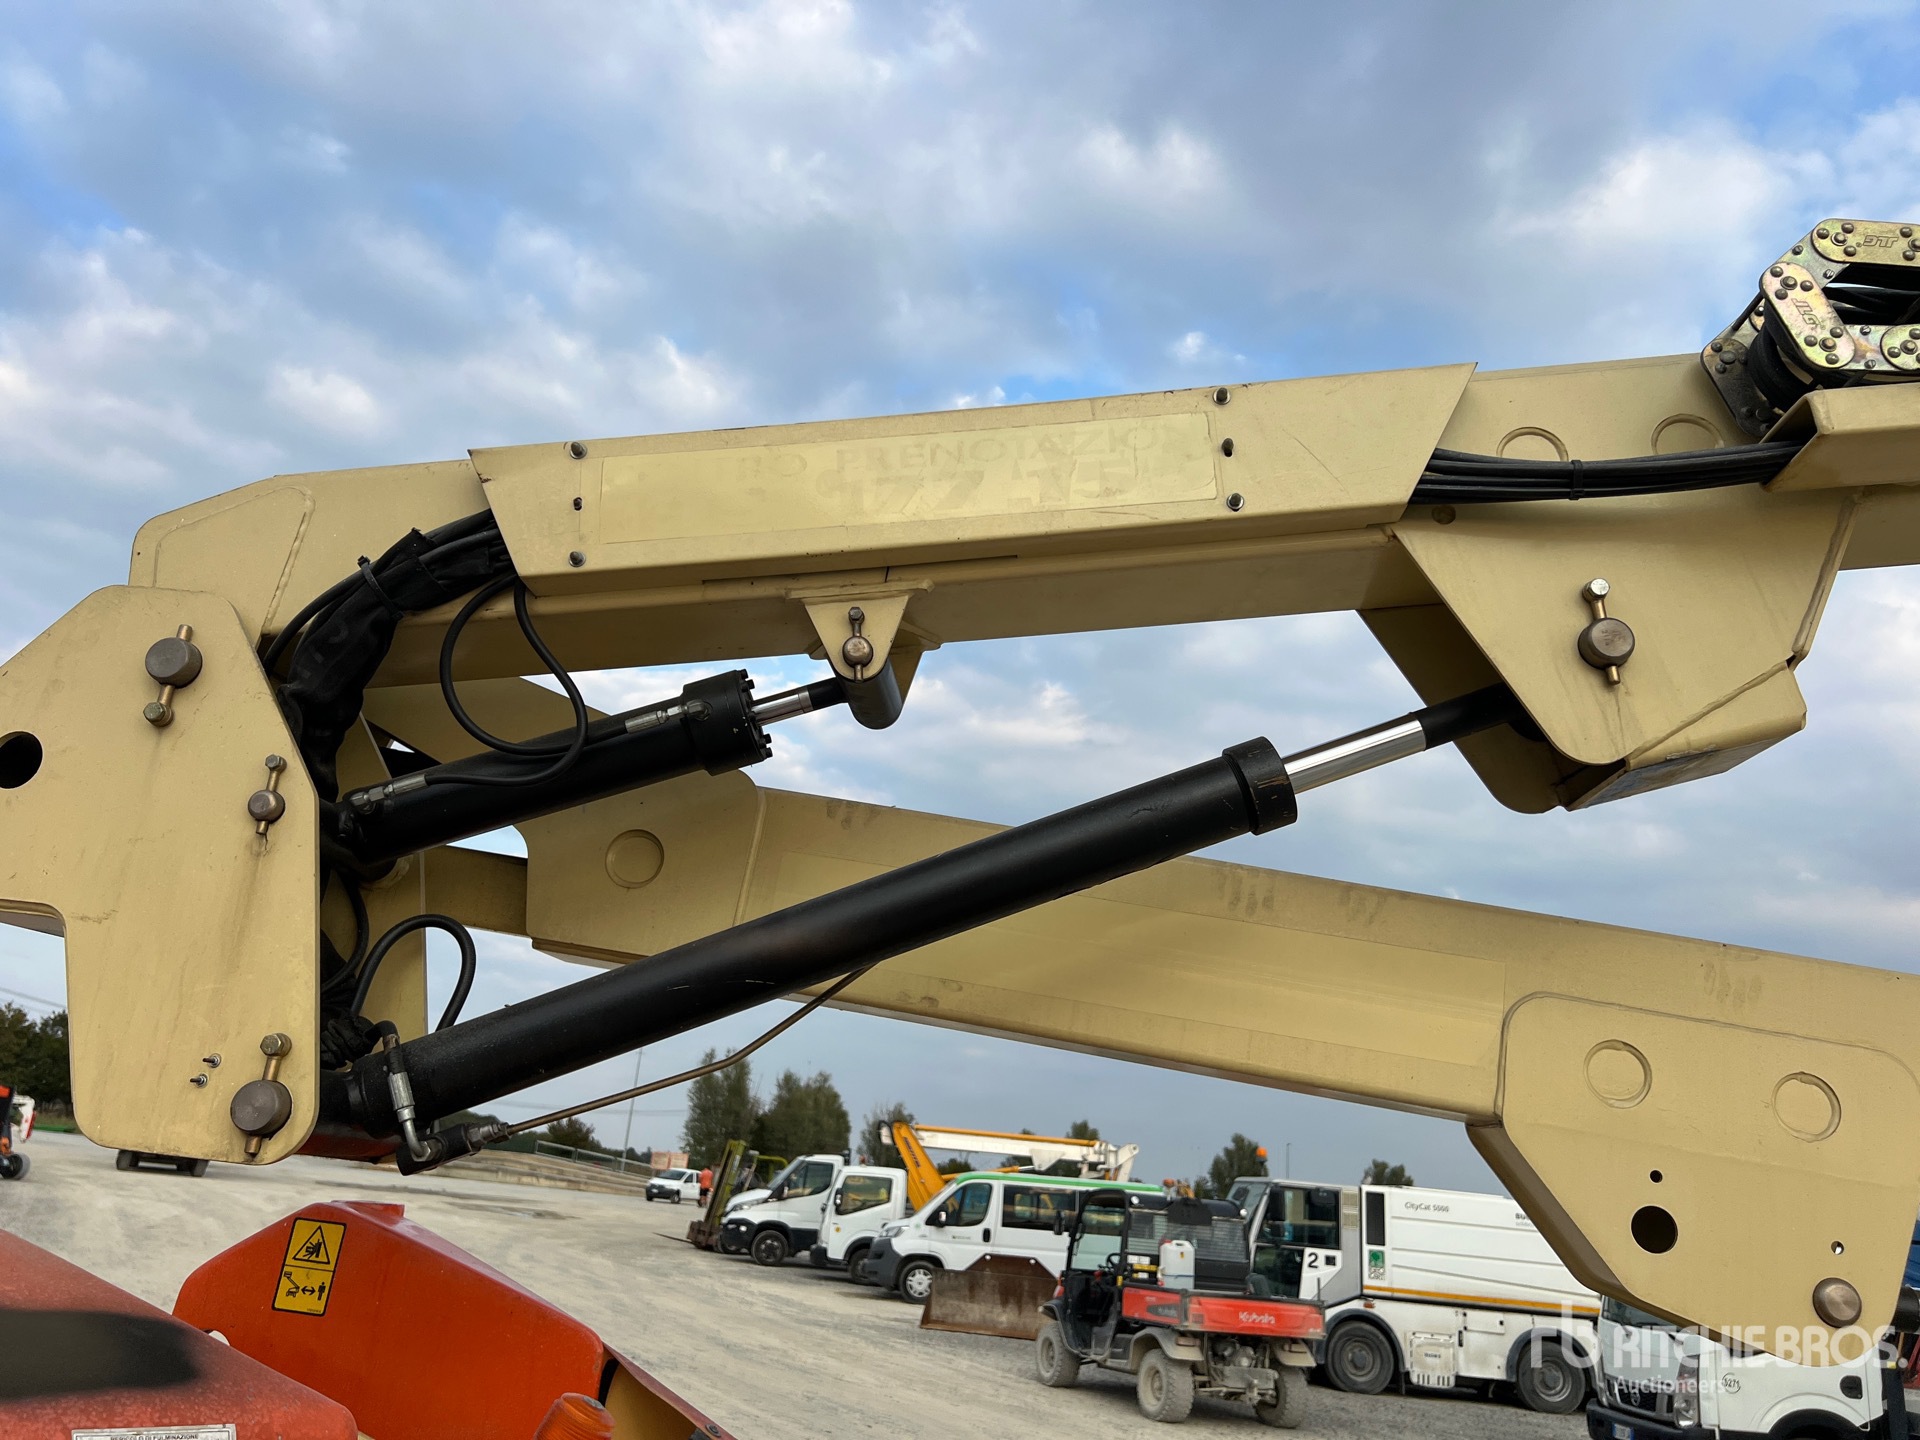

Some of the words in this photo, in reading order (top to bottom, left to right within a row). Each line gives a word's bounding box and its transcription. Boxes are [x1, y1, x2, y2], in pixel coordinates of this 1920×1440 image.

[1863, 234, 1899, 248] JLG
[1791, 298, 1821, 330] JLG
[1308, 1252, 1319, 1268] 2
[1238, 1311, 1276, 1325] Kubota
